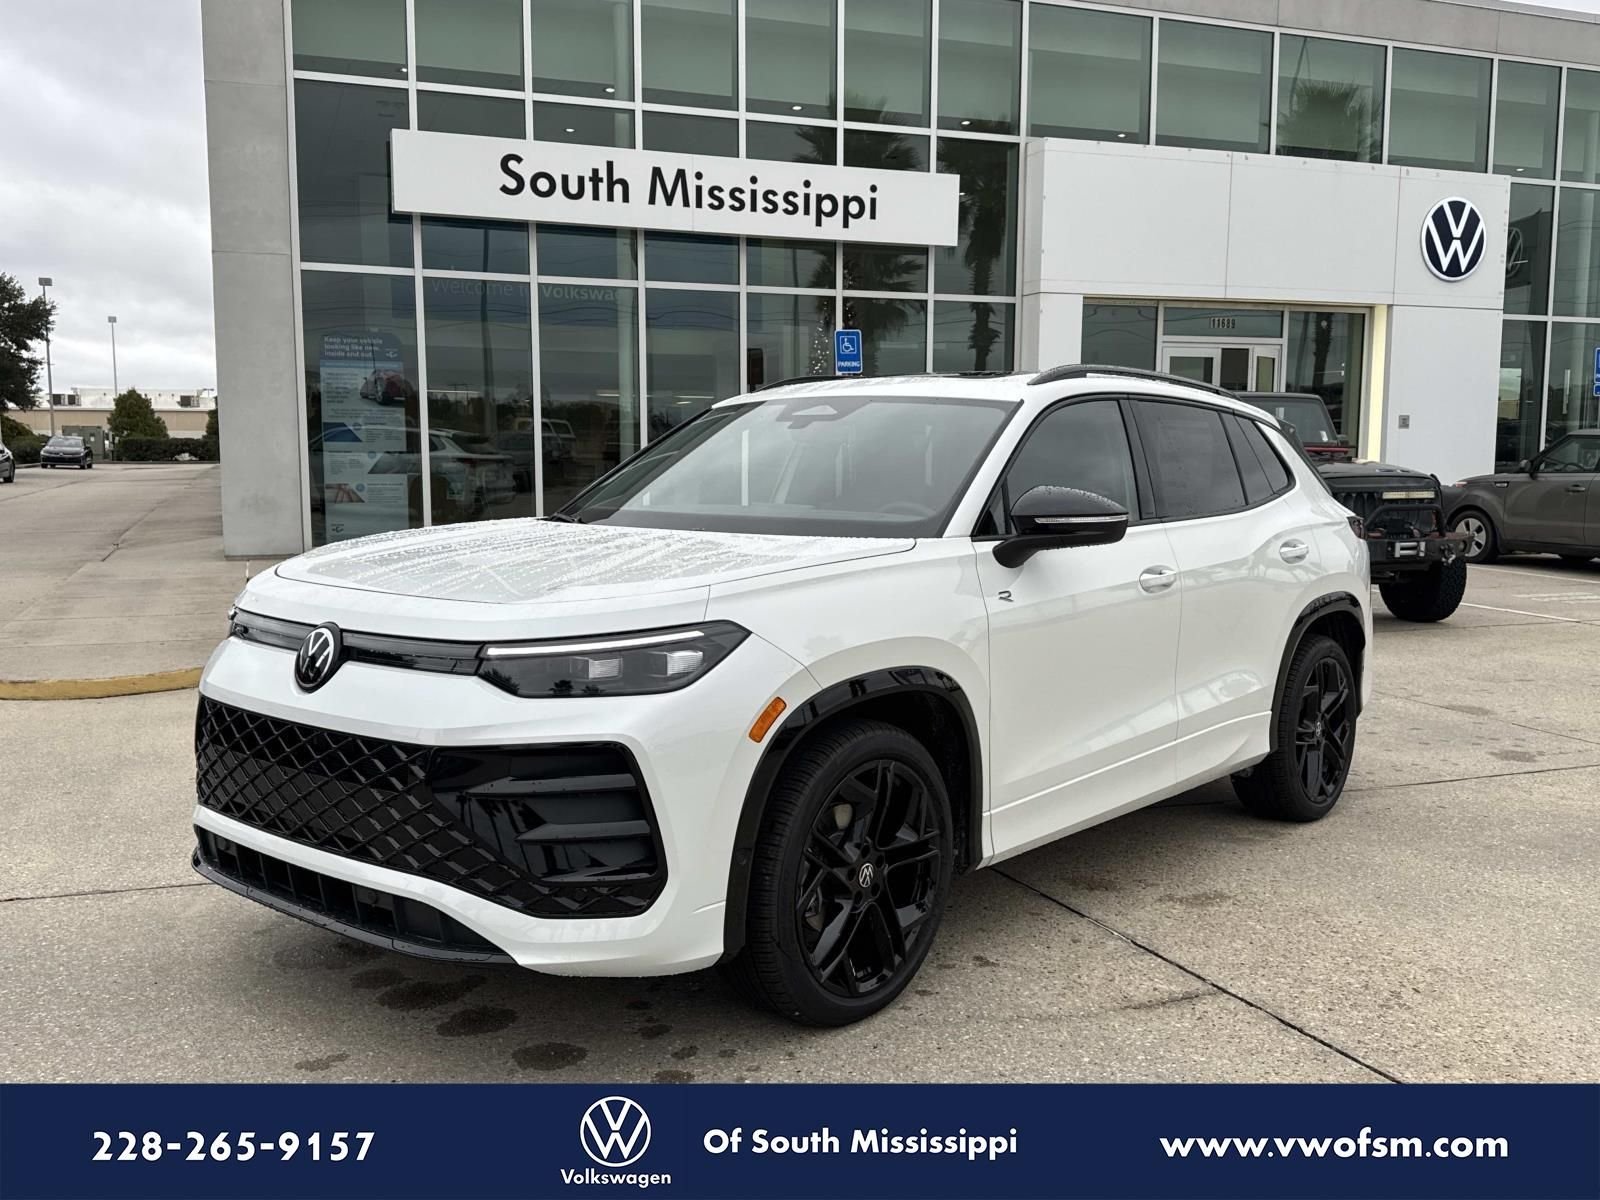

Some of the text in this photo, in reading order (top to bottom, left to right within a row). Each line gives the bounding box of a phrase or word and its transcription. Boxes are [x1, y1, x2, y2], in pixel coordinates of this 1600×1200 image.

[499, 153, 878, 229] South Mississippi
[1211, 318, 1236, 329] 11689
[837, 360, 861, 368] PARKING
